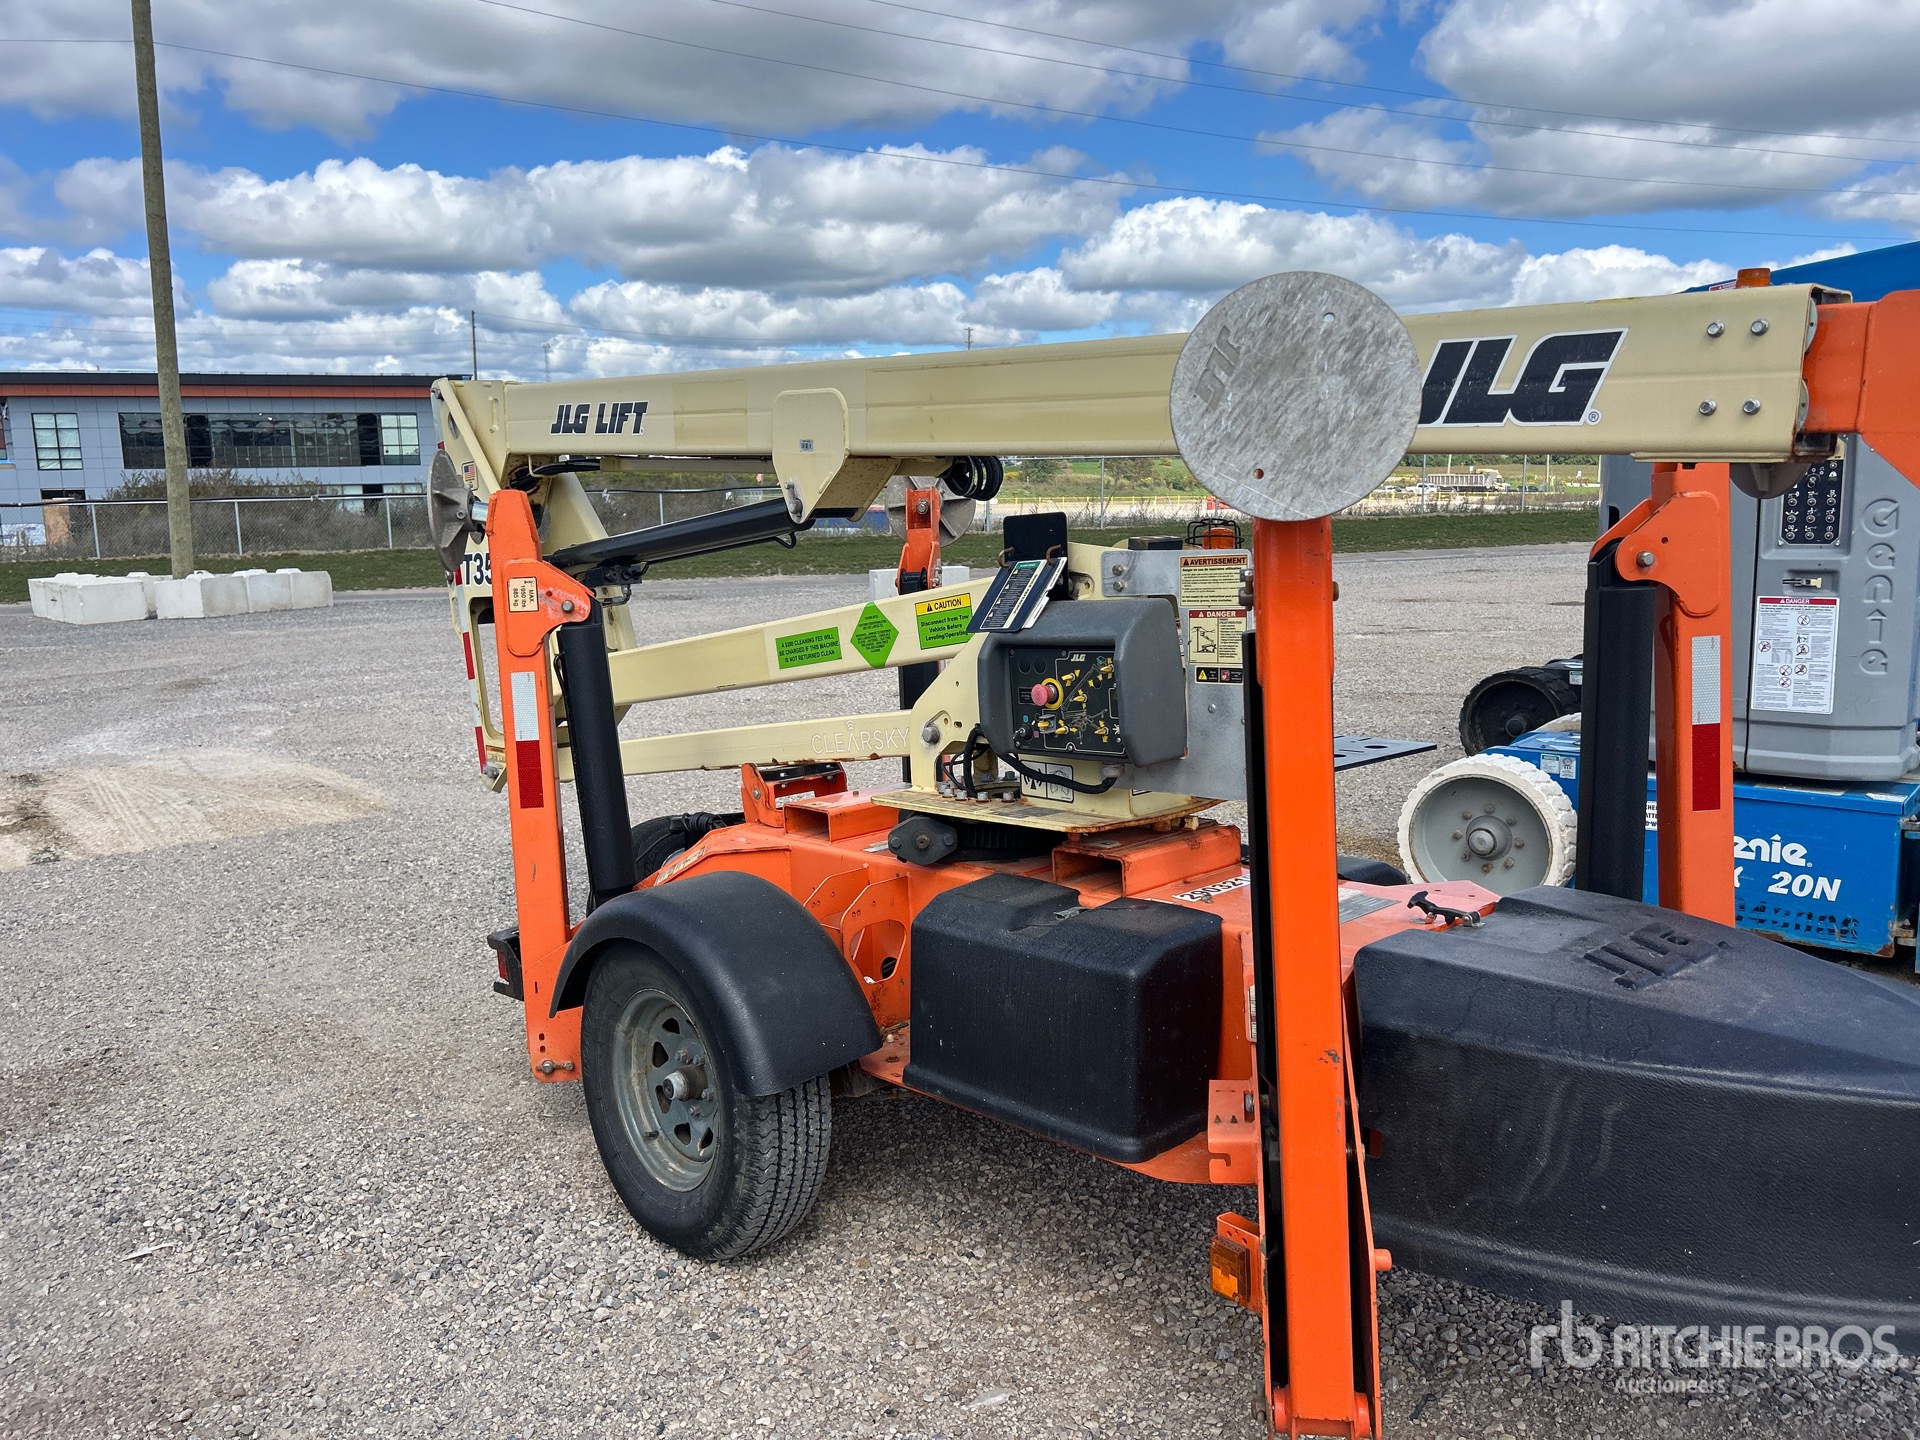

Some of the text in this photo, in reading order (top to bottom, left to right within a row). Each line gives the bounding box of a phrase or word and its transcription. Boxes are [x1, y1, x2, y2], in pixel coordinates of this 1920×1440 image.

[1418, 328, 1628, 426] JLG
[550, 401, 648, 435] JLG LIFT
[1190, 557, 1246, 565] AVERTISSEMENT
[934, 598, 962, 610] CAUTION
[921, 618, 946, 627] Disconnect
[929, 625, 946, 633] Vehicle
[785, 647, 804, 655] CHARGED
[820, 640, 839, 649] MACHINE
[794, 637, 815, 646] CLEANING
[798, 652, 820, 660] RETURNED
[821, 649, 836, 657] CLEAN
[1071, 653, 1086, 662] JLG
[811, 727, 909, 754] CLEARSKY
[1733, 834, 1808, 867] enie
[1767, 871, 1842, 902] 20N
